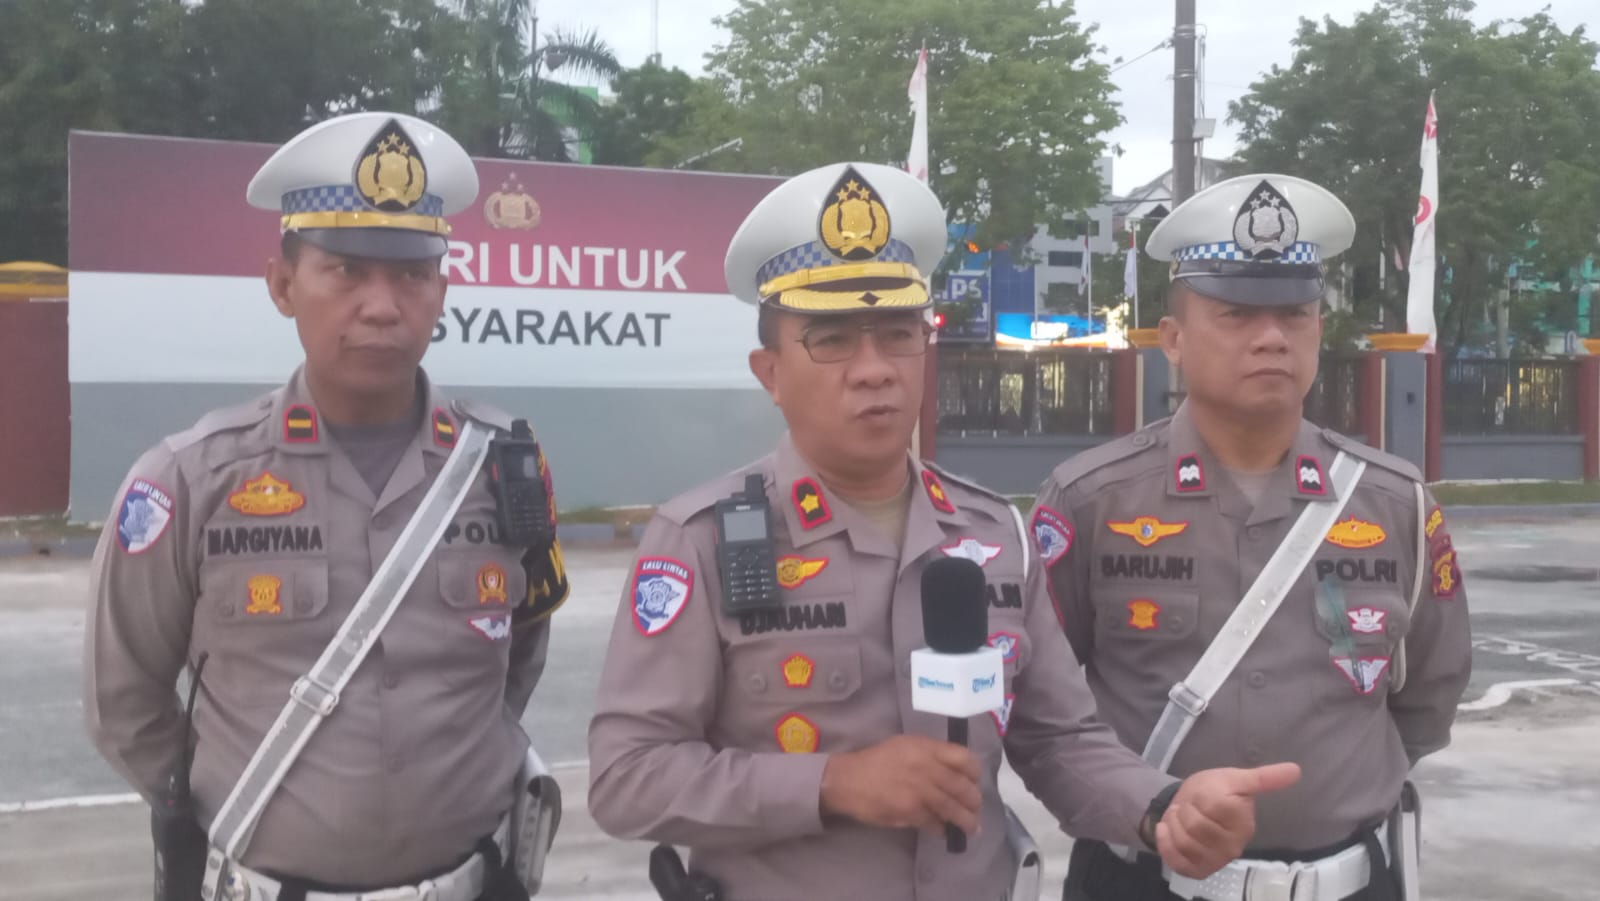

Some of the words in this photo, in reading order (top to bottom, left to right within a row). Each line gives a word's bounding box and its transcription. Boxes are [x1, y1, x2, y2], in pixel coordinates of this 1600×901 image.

[440, 240, 489, 283] RI
[510, 243, 687, 290] UNTUK
[430, 307, 671, 347] SYARAKAT
[443, 522, 502, 544] POL
[642, 560, 662, 570] LALU
[662, 561, 688, 580] LINTAS
[1315, 557, 1397, 583] POLRI
